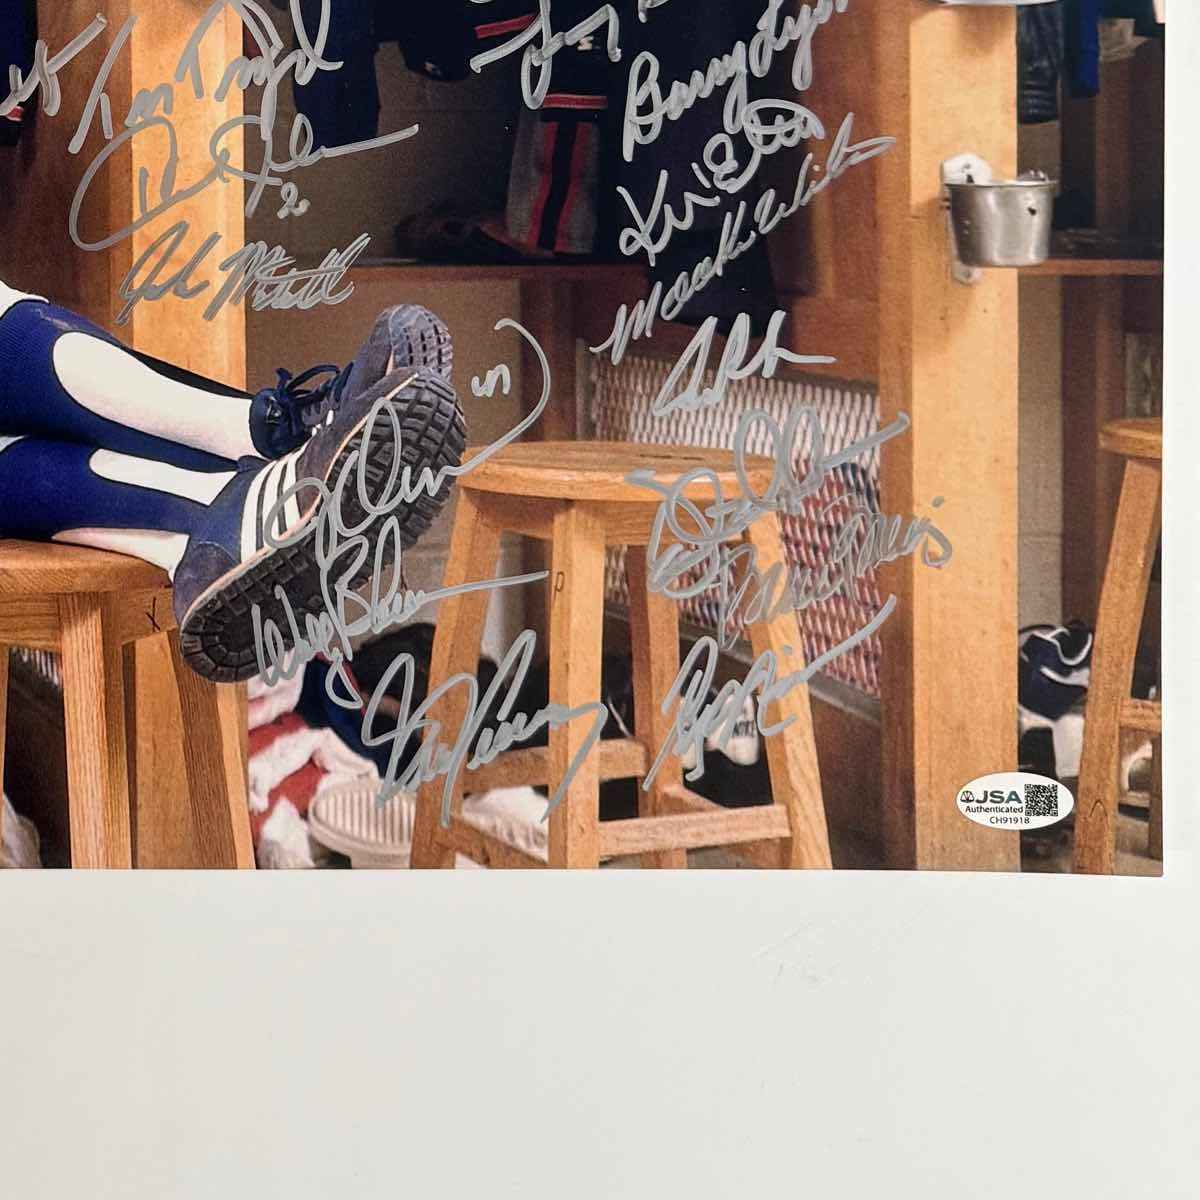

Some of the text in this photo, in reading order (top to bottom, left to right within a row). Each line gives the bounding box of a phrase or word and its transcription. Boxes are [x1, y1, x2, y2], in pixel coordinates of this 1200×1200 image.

[975, 790, 1022, 804] JSA
[965, 805, 1024, 813] Authenticated
[989, 816, 1031, 824] CH91918
